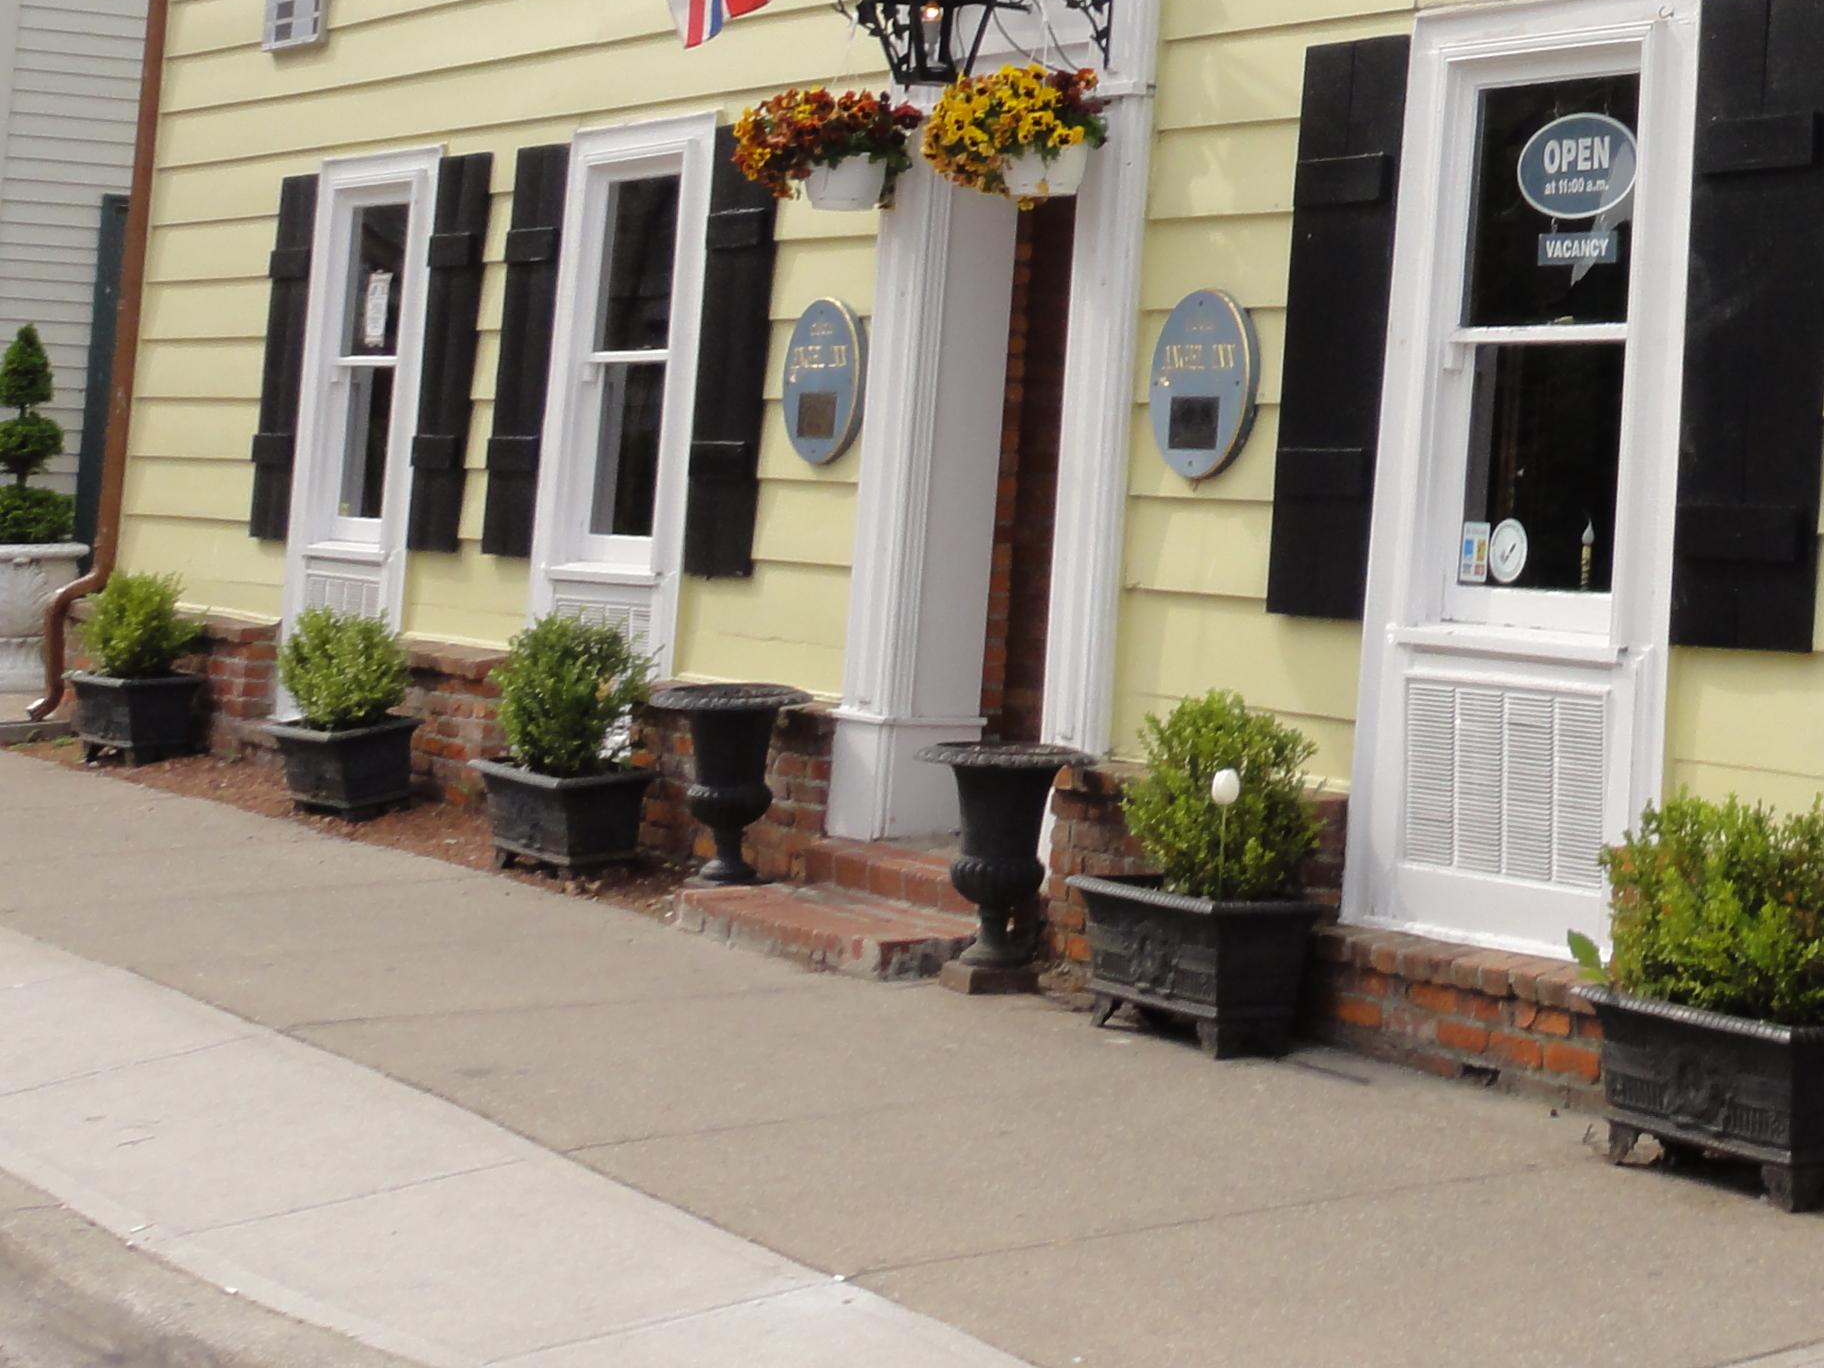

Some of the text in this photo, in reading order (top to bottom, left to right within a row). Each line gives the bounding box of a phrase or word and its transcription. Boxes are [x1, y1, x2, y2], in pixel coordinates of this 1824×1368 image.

[1543, 135, 1610, 174] OPEN
[1544, 177, 1609, 195] at 11:00 a.m.
[1545, 238, 1609, 259] VACANCY
